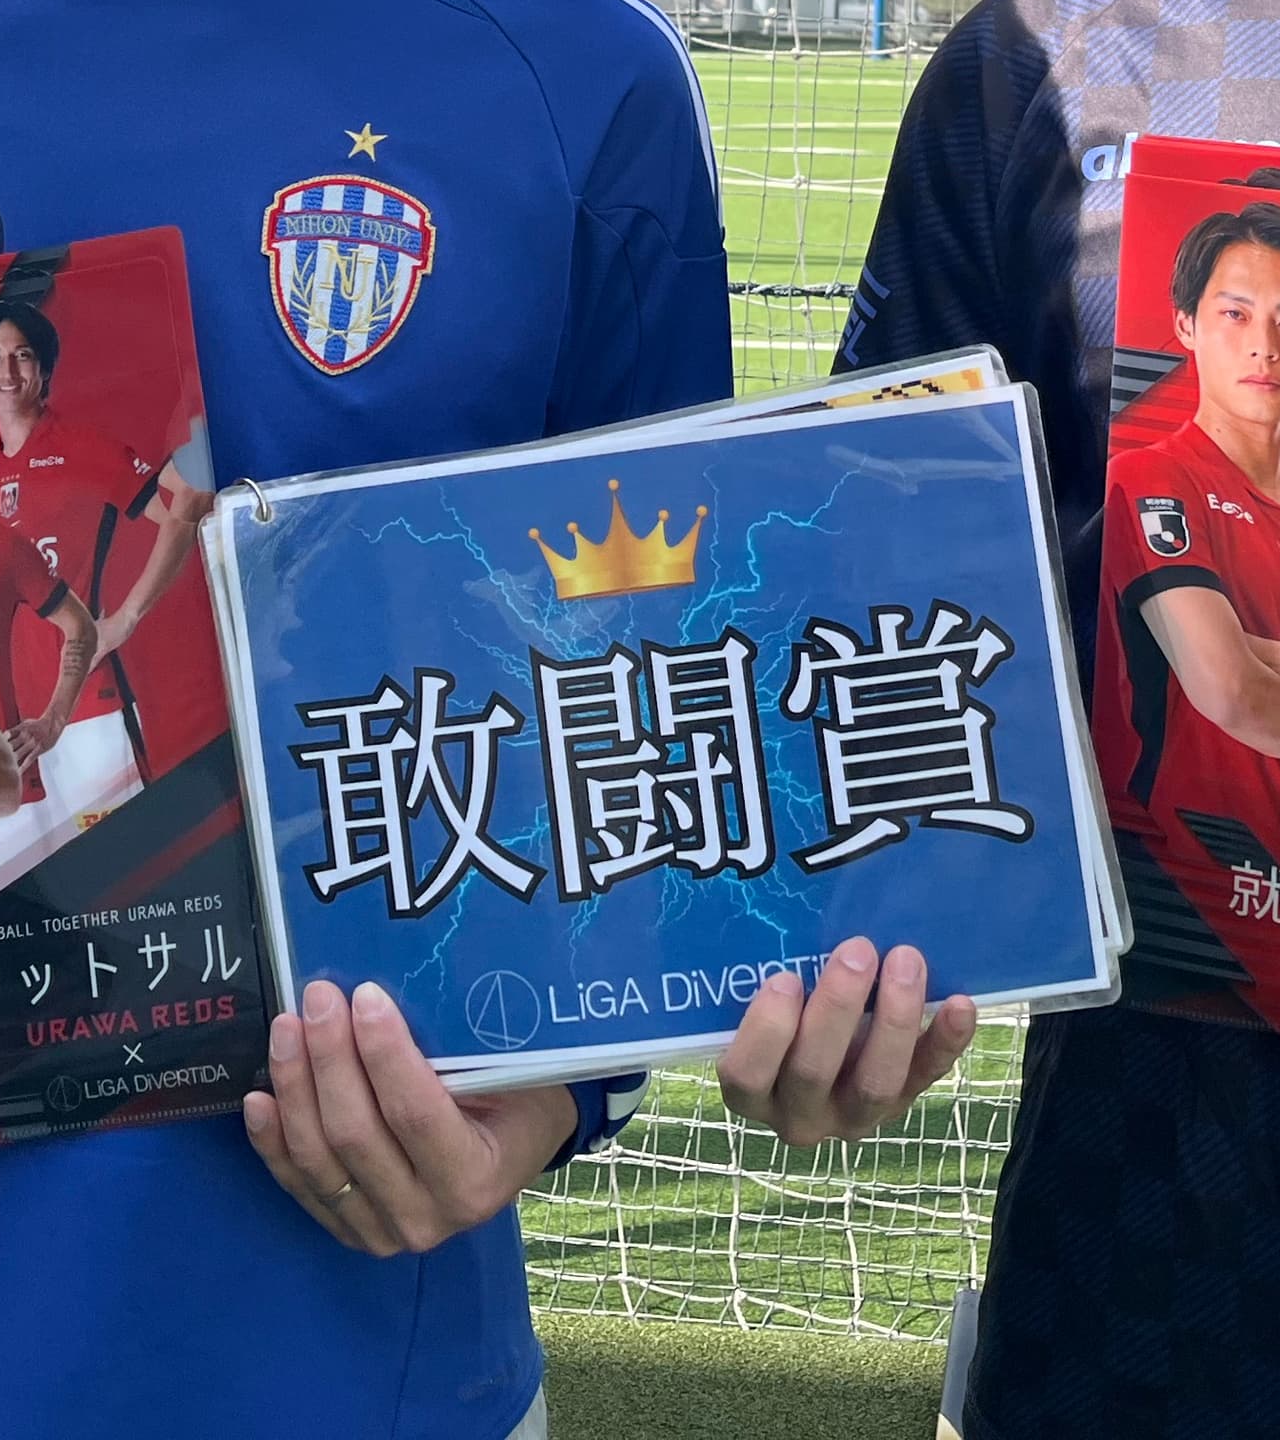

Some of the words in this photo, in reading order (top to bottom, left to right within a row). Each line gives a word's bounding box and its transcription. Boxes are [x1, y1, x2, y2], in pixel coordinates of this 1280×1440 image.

[296, 599, 1034, 918] 敢闘賞
[42, 909, 119, 933] TOGETHER
[128, 901, 176, 921] URAWA
[184, 894, 222, 913] REDS
[27, 1010, 139, 1047] URAWA
[151, 994, 236, 1029] REDS
